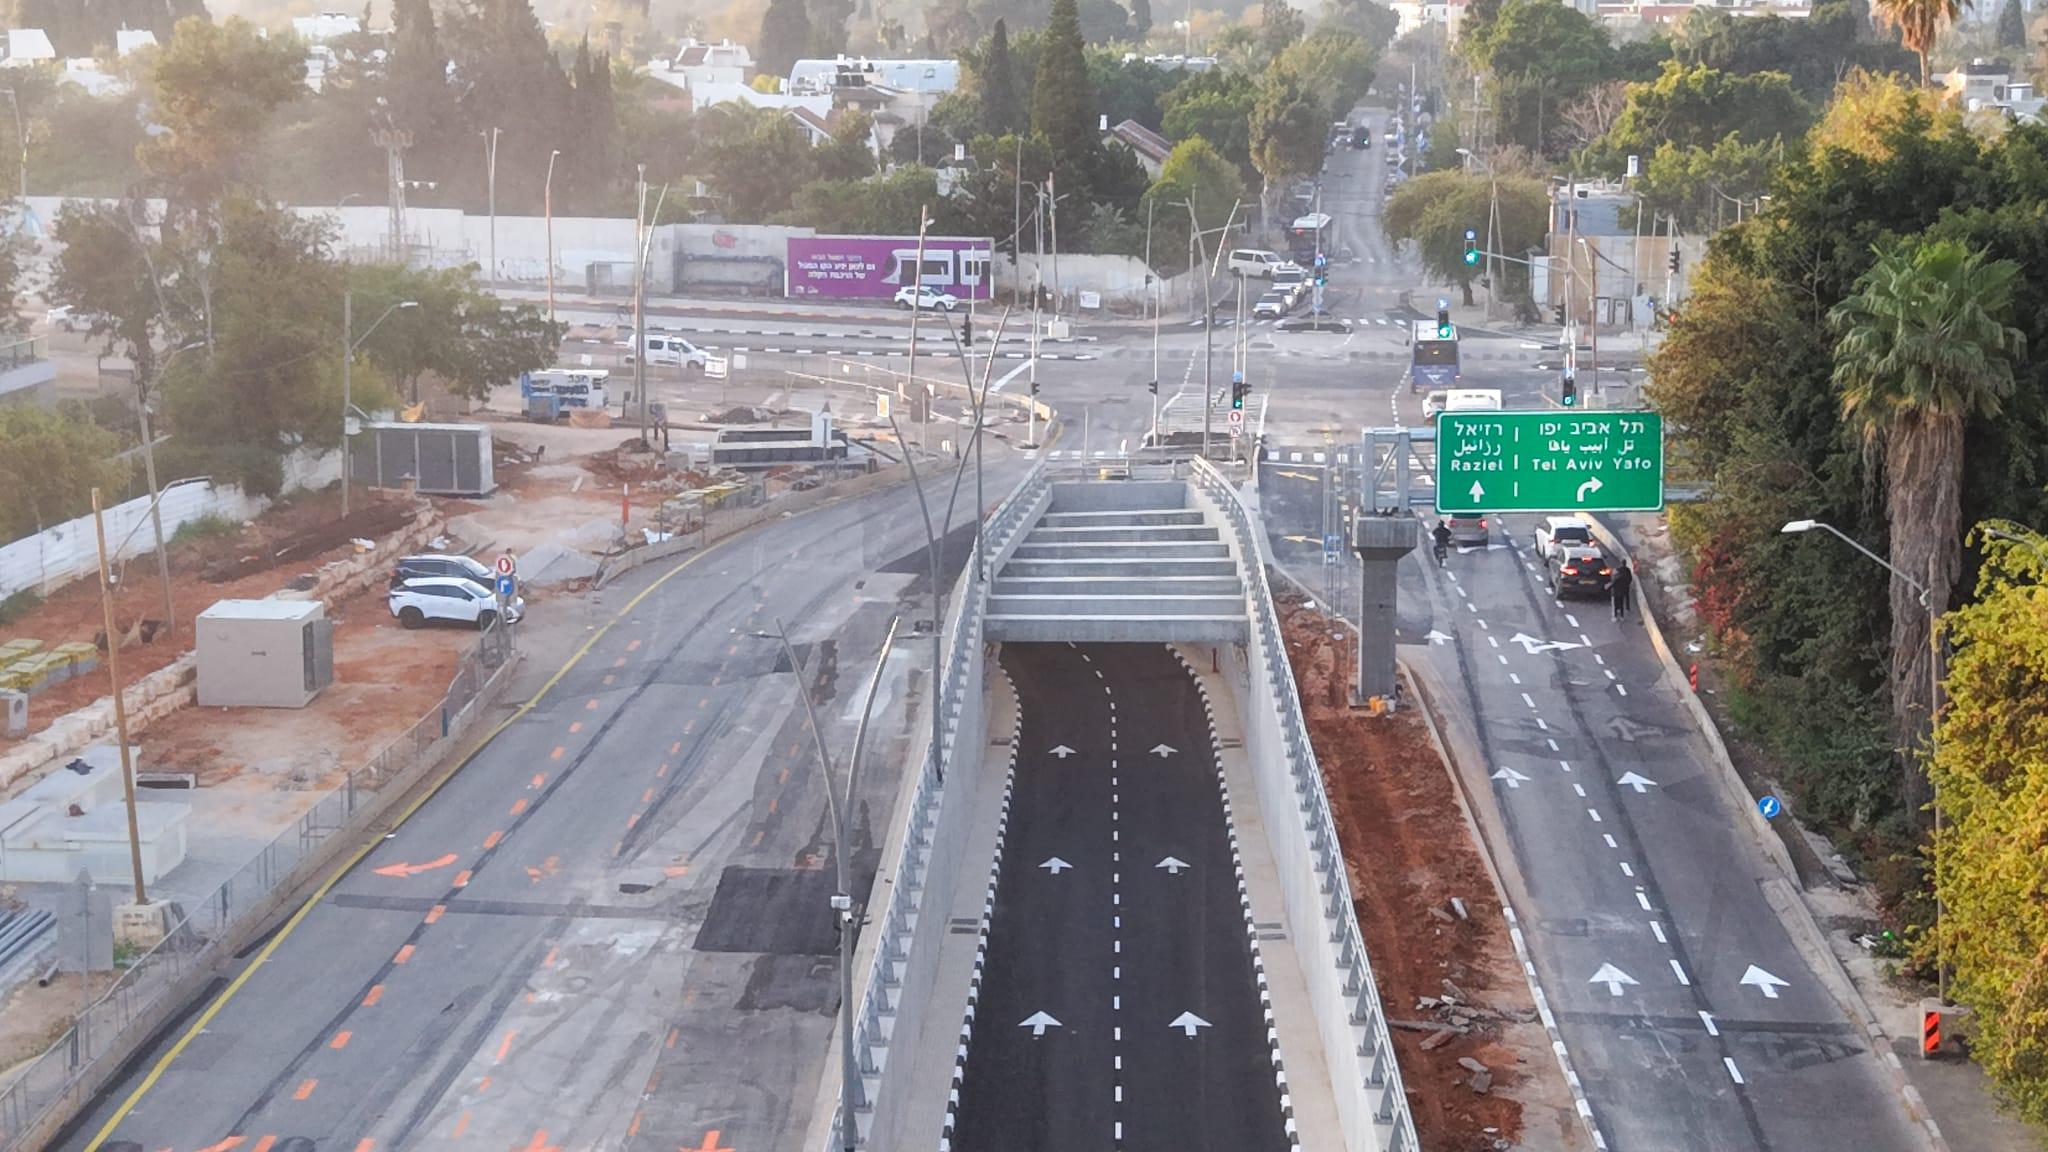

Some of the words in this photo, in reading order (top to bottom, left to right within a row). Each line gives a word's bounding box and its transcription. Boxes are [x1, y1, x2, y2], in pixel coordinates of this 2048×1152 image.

[1454, 421, 1502, 436] רזיאל
[1539, 423, 1561, 436] יפו
[1569, 422, 1610, 435] אביב
[1619, 419, 1644, 434] תל
[1617, 439, 1634, 456] تل
[1451, 459, 1503, 471] Raziel
[1532, 458, 1557, 471] Tel
[1566, 457, 1603, 471] Aviv
[1613, 457, 1651, 470] Yafo
